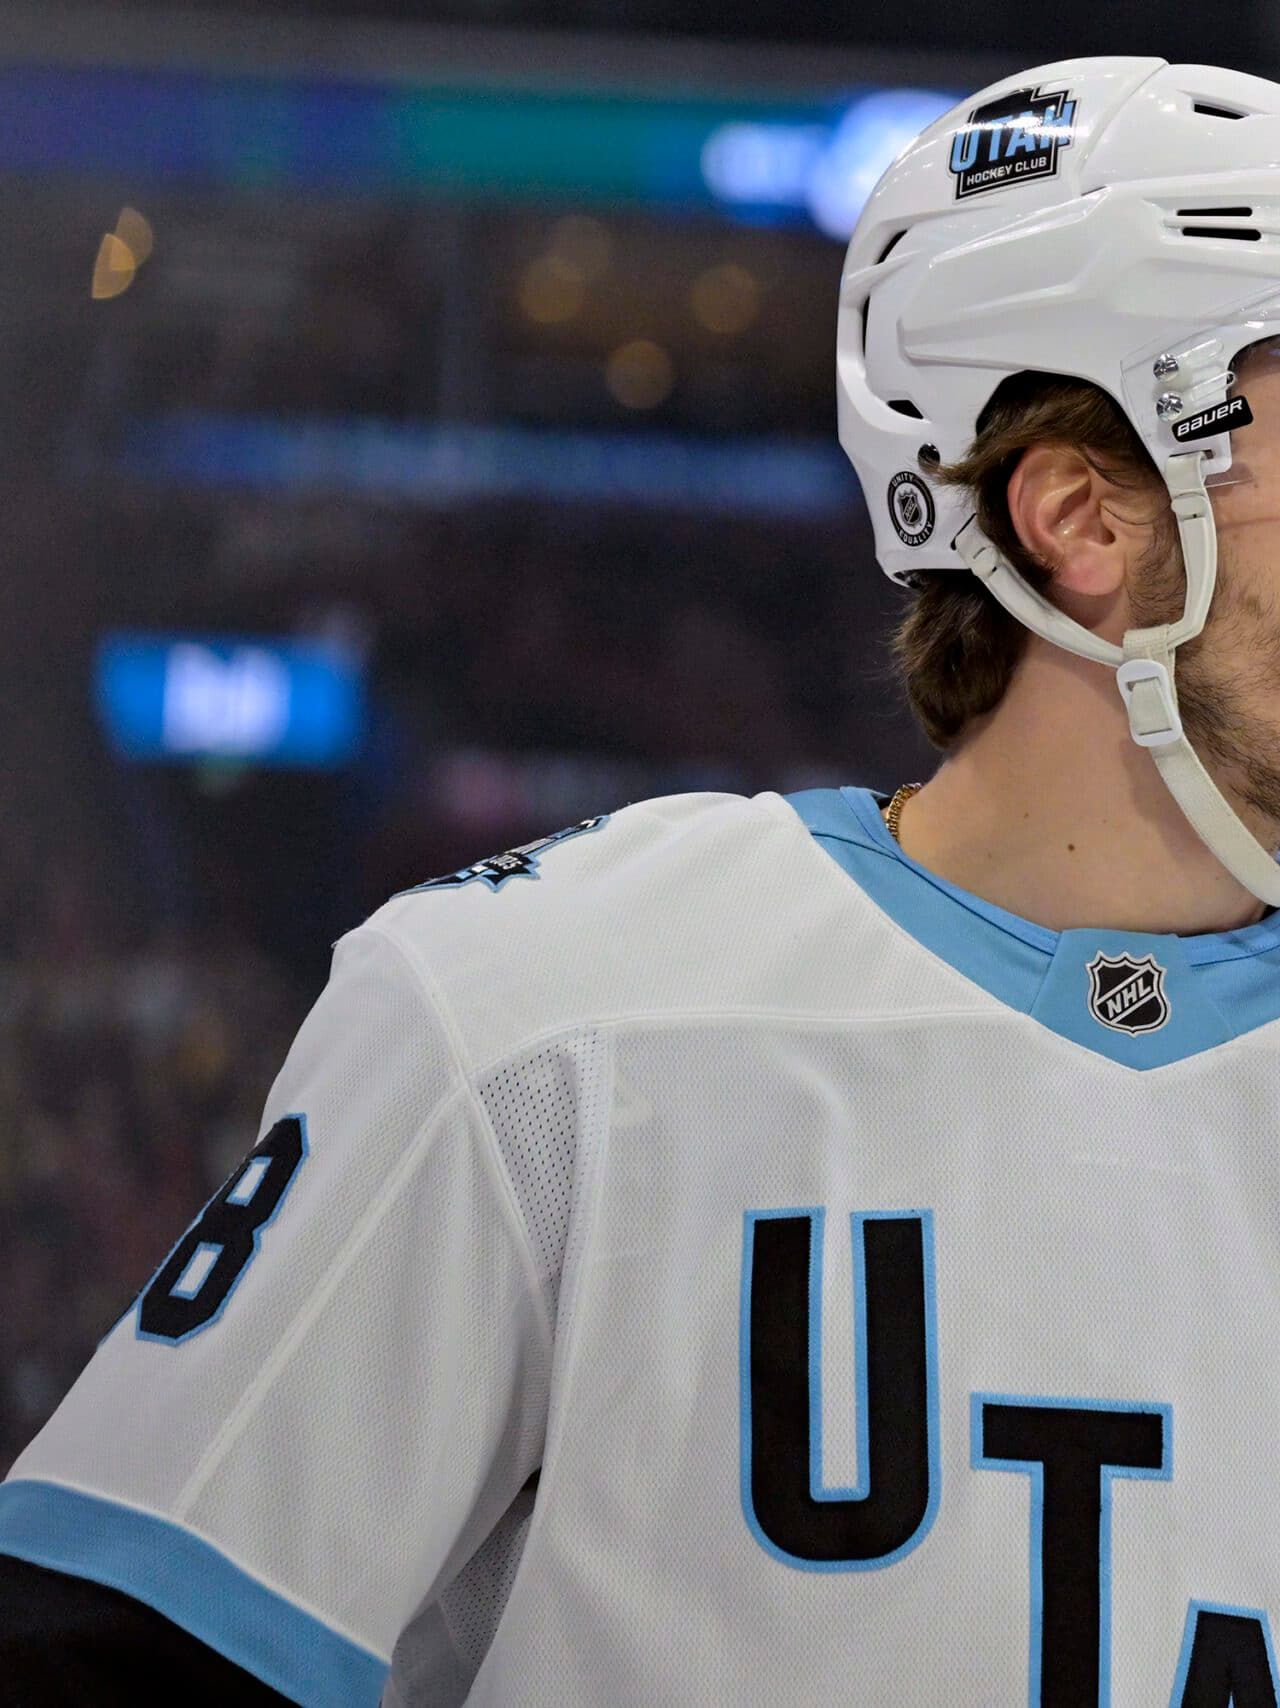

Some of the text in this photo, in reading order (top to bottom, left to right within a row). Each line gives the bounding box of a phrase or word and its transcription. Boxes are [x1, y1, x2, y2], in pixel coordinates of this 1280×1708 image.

[950, 101, 1076, 172] UTAH
[966, 156, 1047, 186] HOCKEY CLUB
[1177, 399, 1243, 437] BAUER
[891, 472, 914, 487] UNITY
[899, 521, 933, 545] EQUALITY
[1105, 977, 1152, 1019] NHL
[136, 1113, 310, 1347] 8
